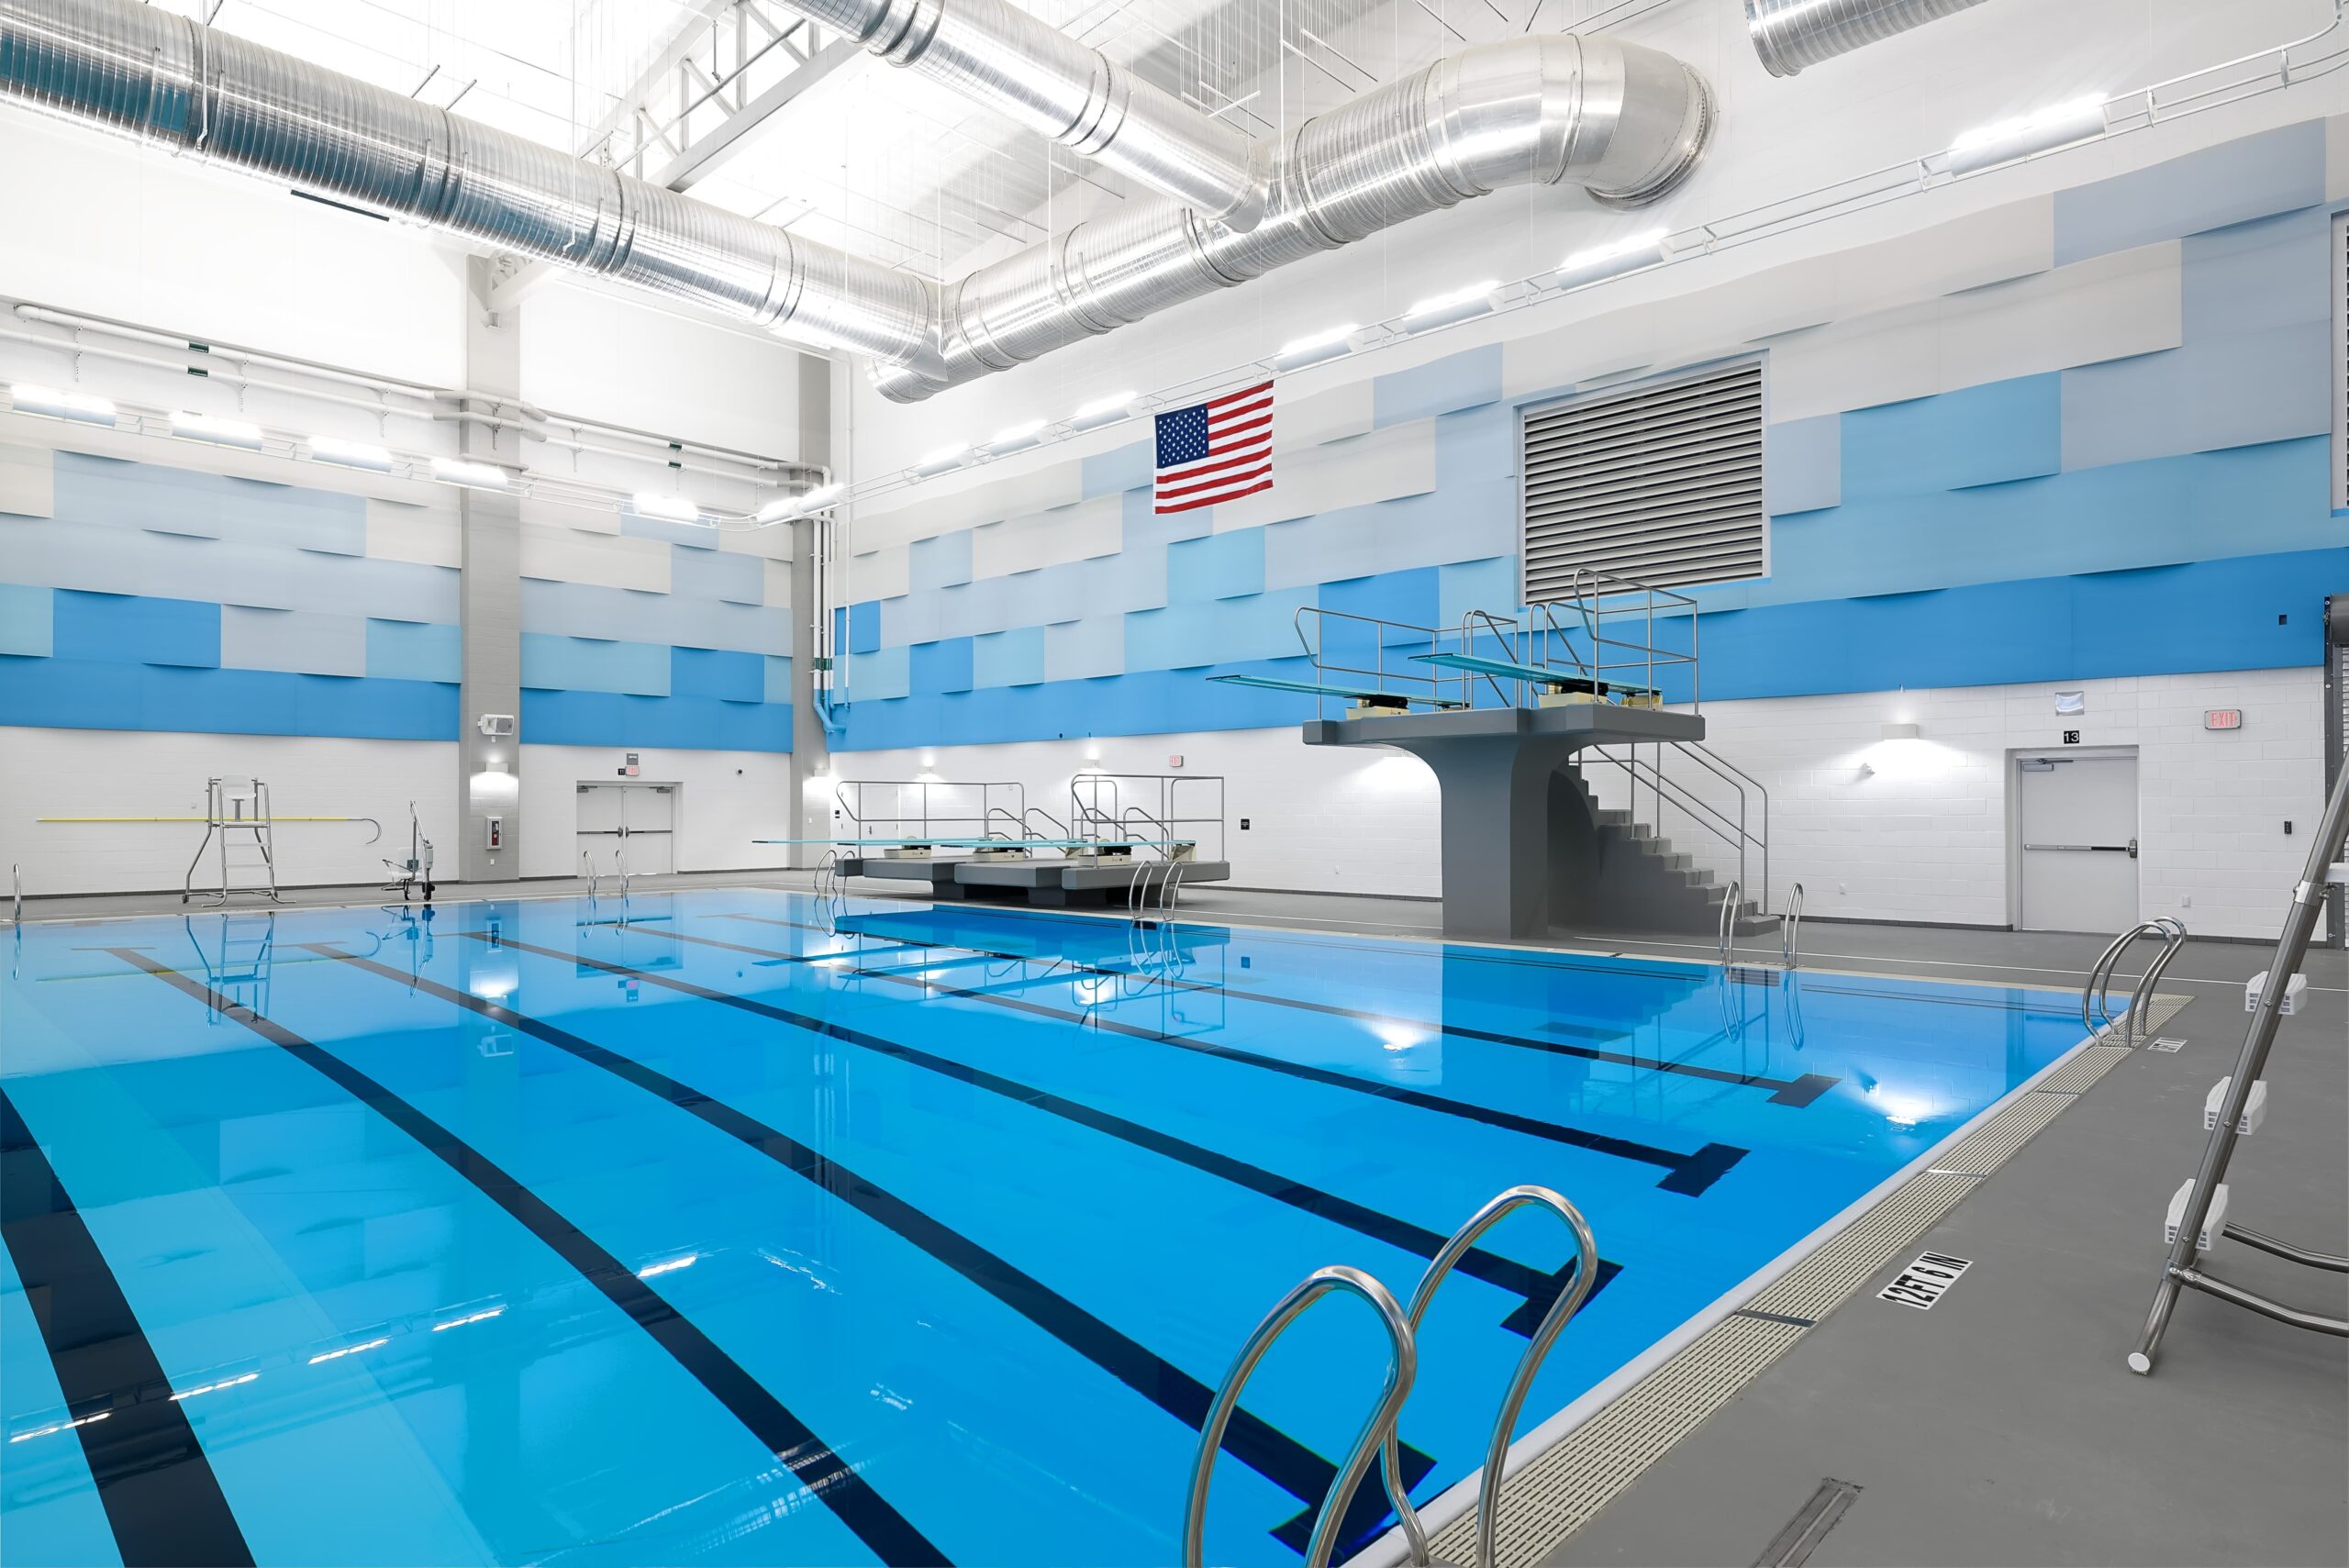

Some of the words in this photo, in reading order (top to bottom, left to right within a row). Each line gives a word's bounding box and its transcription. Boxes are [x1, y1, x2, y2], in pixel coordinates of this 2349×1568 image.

[2211, 712, 2235, 727] EXIT
[2064, 732, 2079, 742] 13
[1919, 1252, 1969, 1271] IN
[1910, 1266, 1954, 1279] 6
